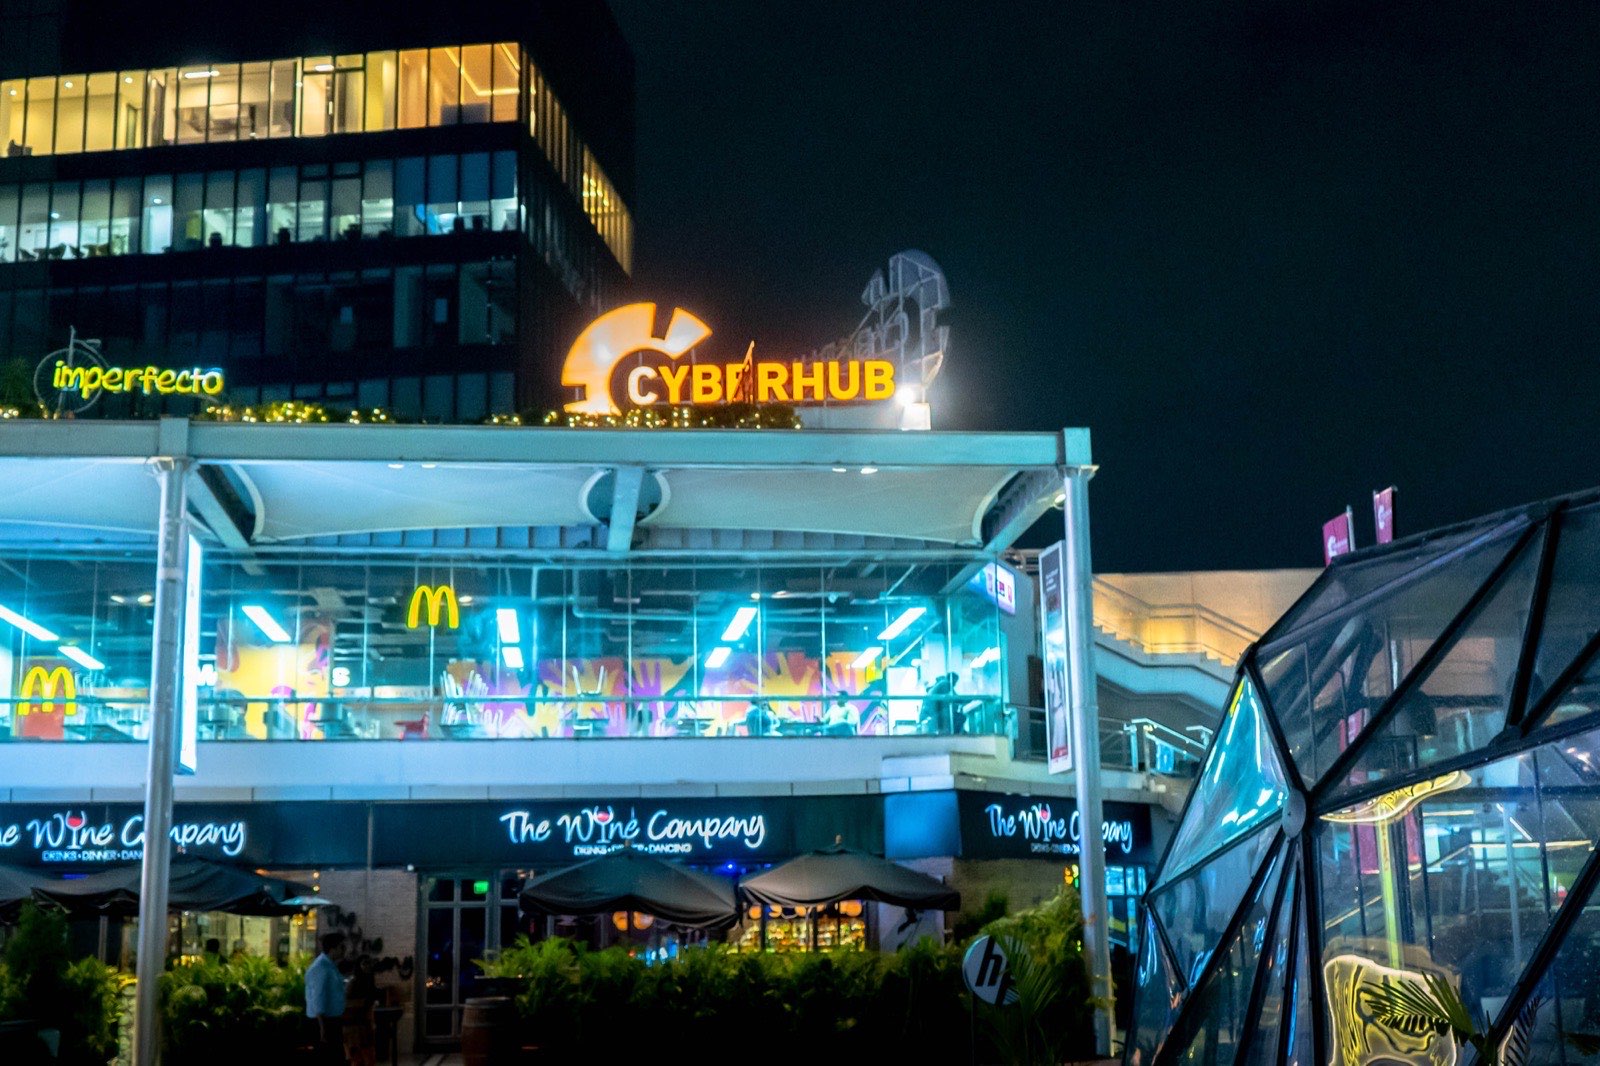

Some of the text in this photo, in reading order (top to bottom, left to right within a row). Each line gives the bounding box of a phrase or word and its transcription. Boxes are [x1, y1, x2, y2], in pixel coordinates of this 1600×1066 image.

[53, 360, 224, 400] imperfecto
[500, 805, 765, 849] The Wine Company
[985, 803, 1016, 837] The
